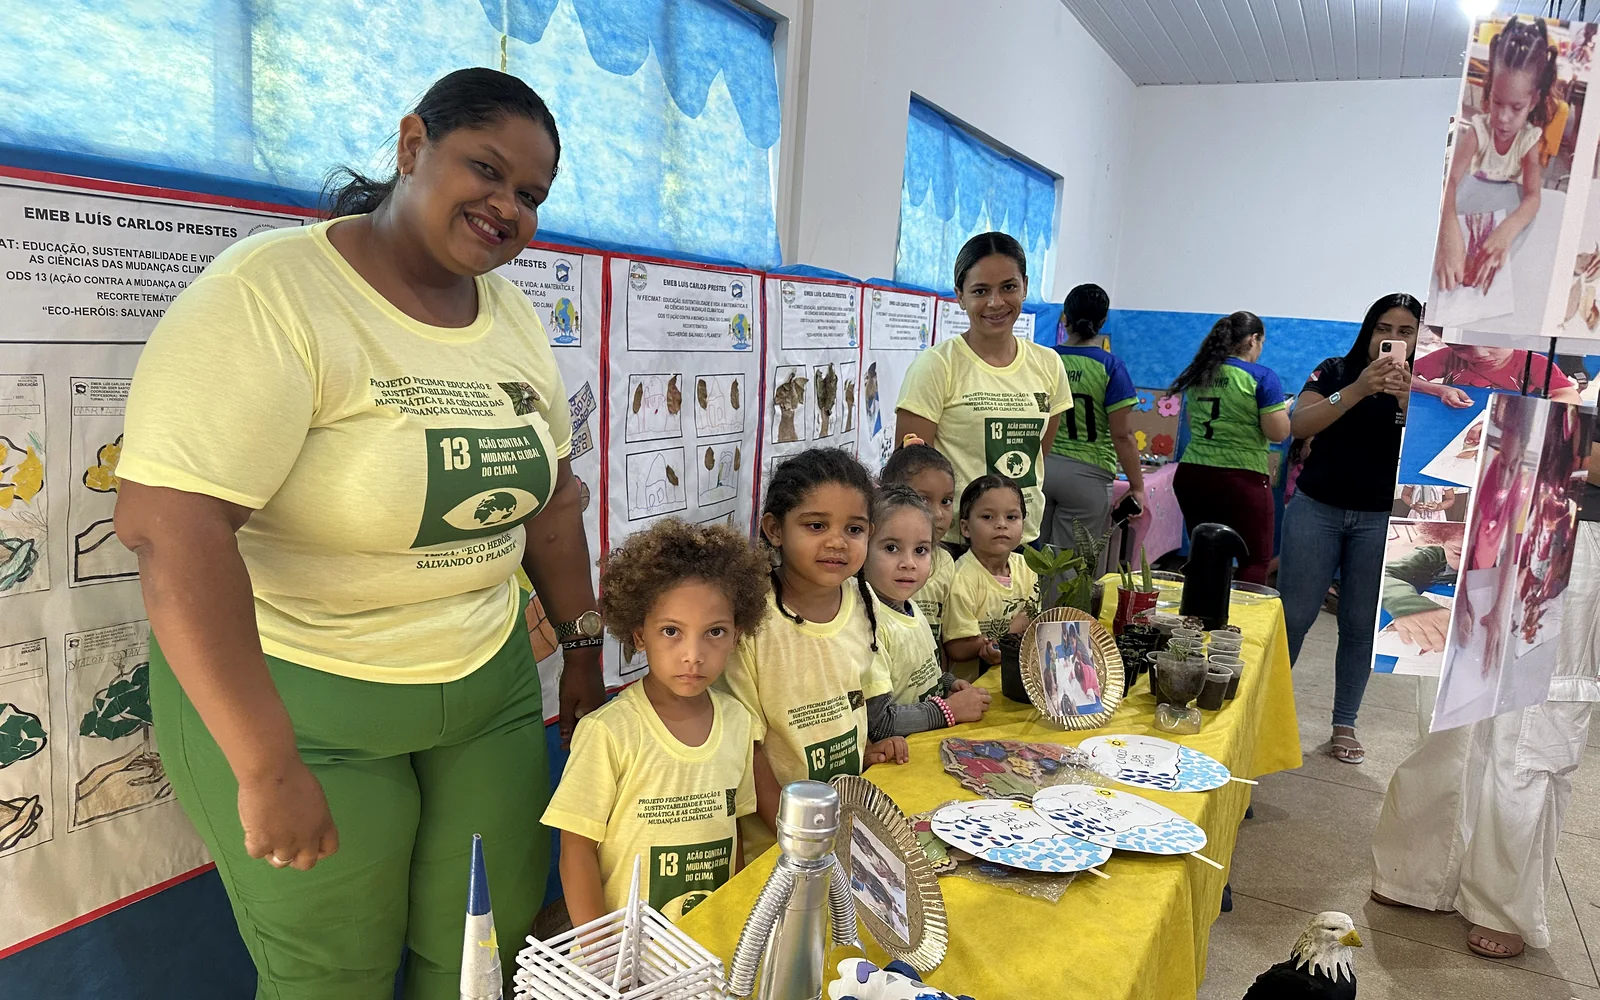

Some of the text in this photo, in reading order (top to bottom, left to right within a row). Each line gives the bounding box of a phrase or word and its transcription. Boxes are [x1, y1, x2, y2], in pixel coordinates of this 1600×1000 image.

[24, 206, 238, 238] EMEB LUÍS CARLOS PRESTES
[0, 238, 215, 264] AT: EDUCAÇÃO, SUSTENTABILIDADE E VID
[29, 254, 205, 274] AS CIÊNCIAS DAS MUDANÇAS CLIM
[513, 258, 547, 269] PRESTES
[6, 270, 32, 281] ODS
[35, 272, 47, 282] 13
[49, 272, 82, 284] (AÇÃO
[84, 275, 124, 286] CONTRA
[125, 278, 133, 286] A
[134, 278, 176, 289] MUDANÇA
[663, 278, 678, 287] EMEB
[689, 282, 707, 291] CARLOS
[707, 283, 727, 292] PRESTES
[97, 291, 177, 302] RECORTE TEMÁTIC
[120, 308, 166, 318] SALVAND
[370, 376, 411, 388] PROJETO
[412, 375, 446, 387] FECIMAT
[446, 380, 485, 391] EDUCAÇÃO
[381, 386, 464, 398] SUSTENTABILIDADE
[465, 390, 470, 398] E
[375, 396, 505, 408] MATEMÁTICA E AS CIÊNCIAS DAS
[400, 405, 450, 416] MUDANÇAS
[1197, 396, 1221, 440] 7
[990, 421, 1003, 440] 13
[439, 436, 530, 471] 13 AÇÃO CONTRA A
[481, 447, 541, 463] MUDANÇA GLOBAL
[481, 464, 518, 477] DO CLIMA
[416, 556, 473, 569] SALVANDO
[476, 555, 484, 564] O
[787, 705, 807, 715] PROJETO
[810, 747, 826, 771] 13
[638, 797, 664, 805] PROJETO
[665, 795, 690, 803] FECIMAT
[690, 791, 717, 800] EDUCAÇÃO
[644, 799, 699, 811] SUSTENTABILIDADE
[637, 810, 675, 819] MATEMÁTICA
[689, 805, 713, 814] CIÊNCIAS
[648, 816, 681, 825] MUDANÇAS
[658, 847, 727, 877] 13 AÇÃO CONTRA A
[685, 871, 714, 882] DO CLIMA
